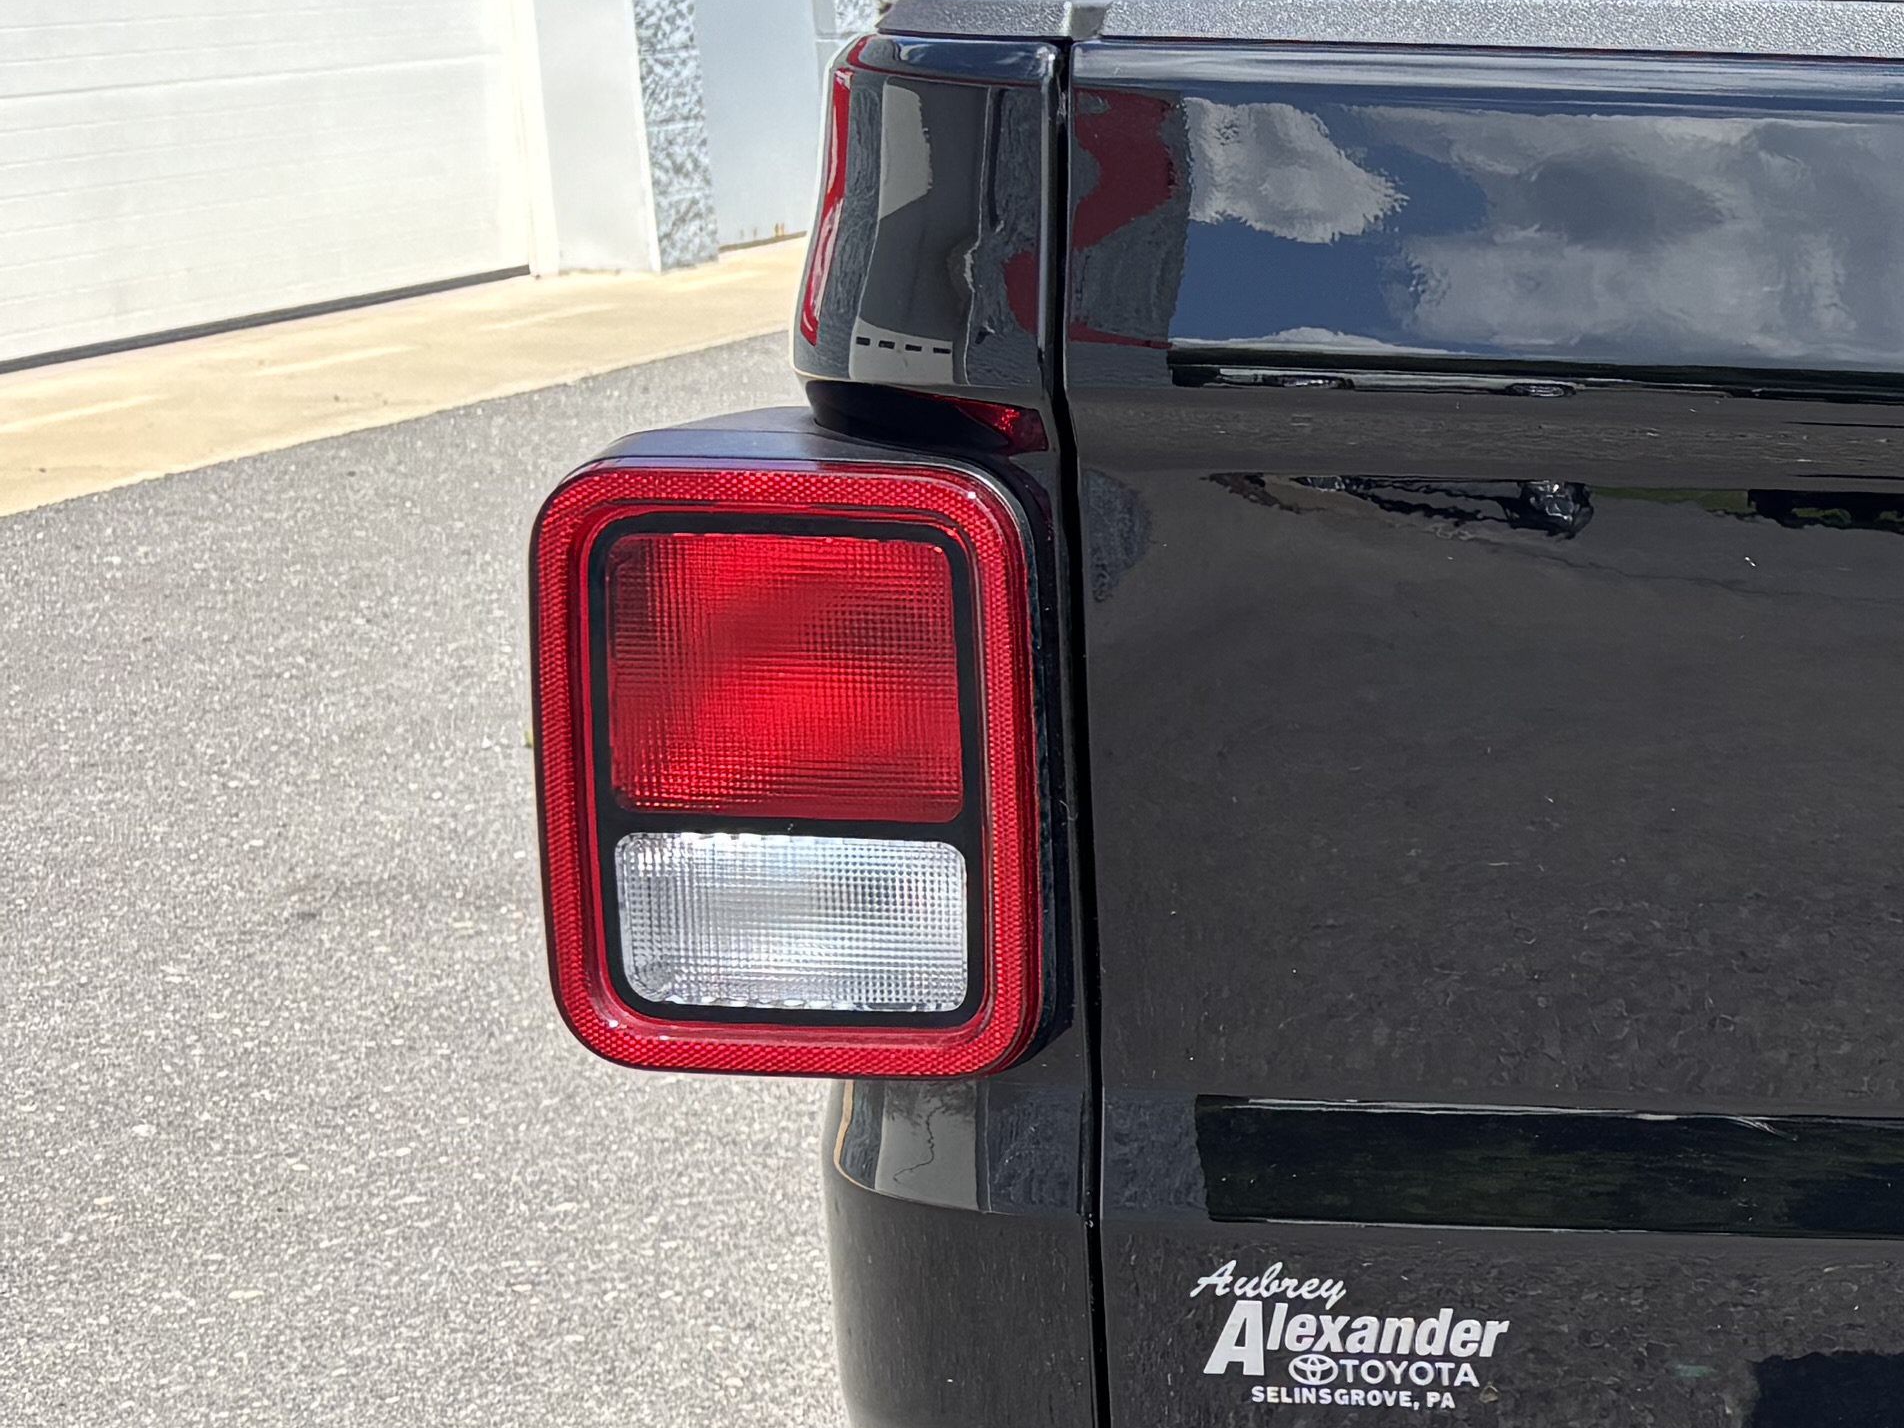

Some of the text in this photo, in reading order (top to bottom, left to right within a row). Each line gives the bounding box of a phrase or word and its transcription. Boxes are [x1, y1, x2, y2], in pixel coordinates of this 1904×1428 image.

[1190, 1259, 1347, 1310] Aubrey
[1203, 1300, 1511, 1376] Alexander
[1338, 1359, 1480, 1388] TOYOTA
[1251, 1386, 1456, 1410] SELINSGROVE, PA
